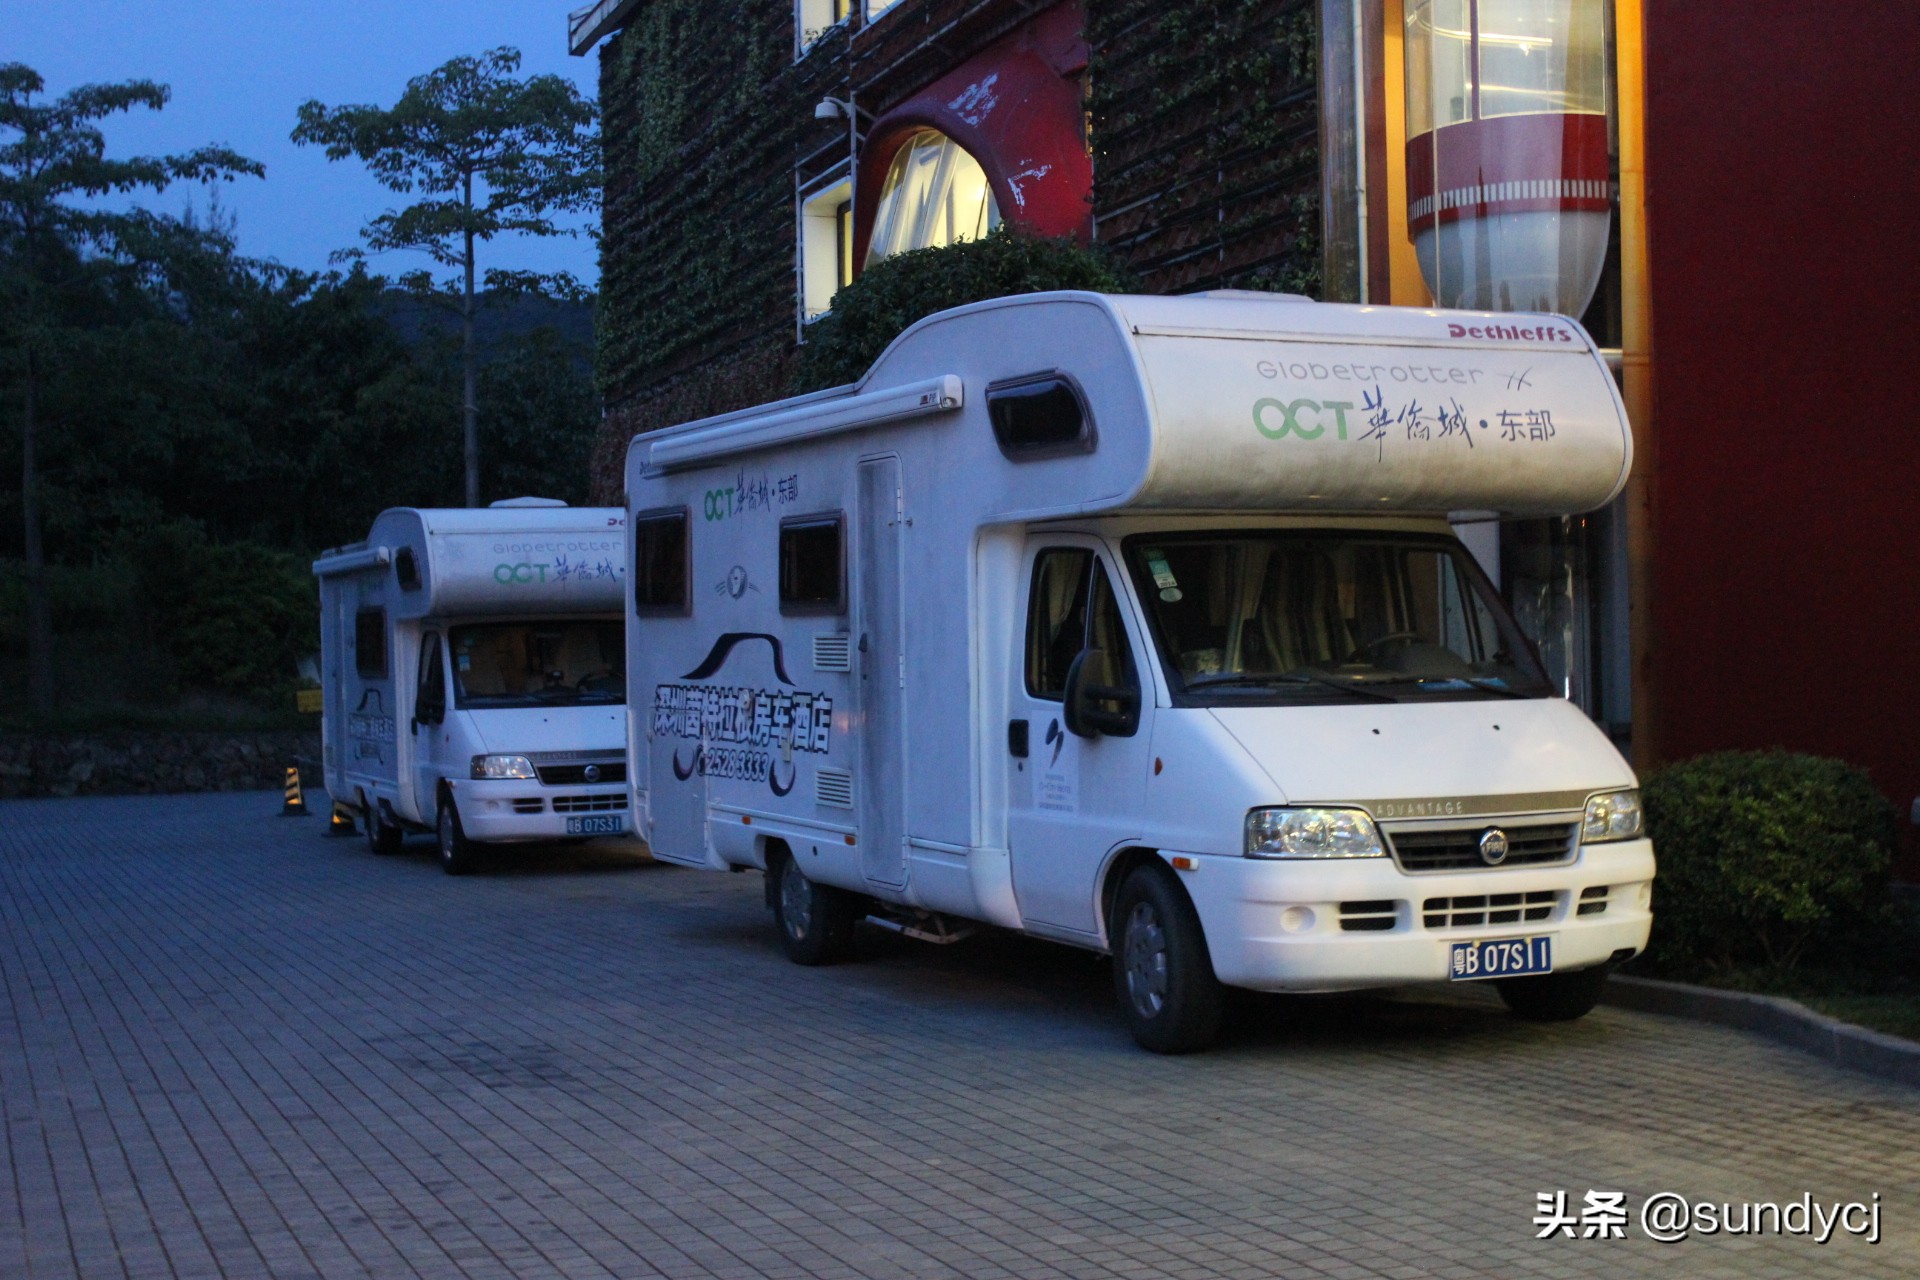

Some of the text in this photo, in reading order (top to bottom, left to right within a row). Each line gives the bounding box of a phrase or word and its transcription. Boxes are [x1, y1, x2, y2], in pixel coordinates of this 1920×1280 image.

[1448, 323, 1572, 342] Dethleffs
[1257, 360, 1484, 385] Globetrotter
[1252, 397, 1354, 441] OCT
[704, 487, 735, 522] OCT
[493, 562, 550, 584] OCT
[1376, 801, 1463, 817] ADVANTAGE
